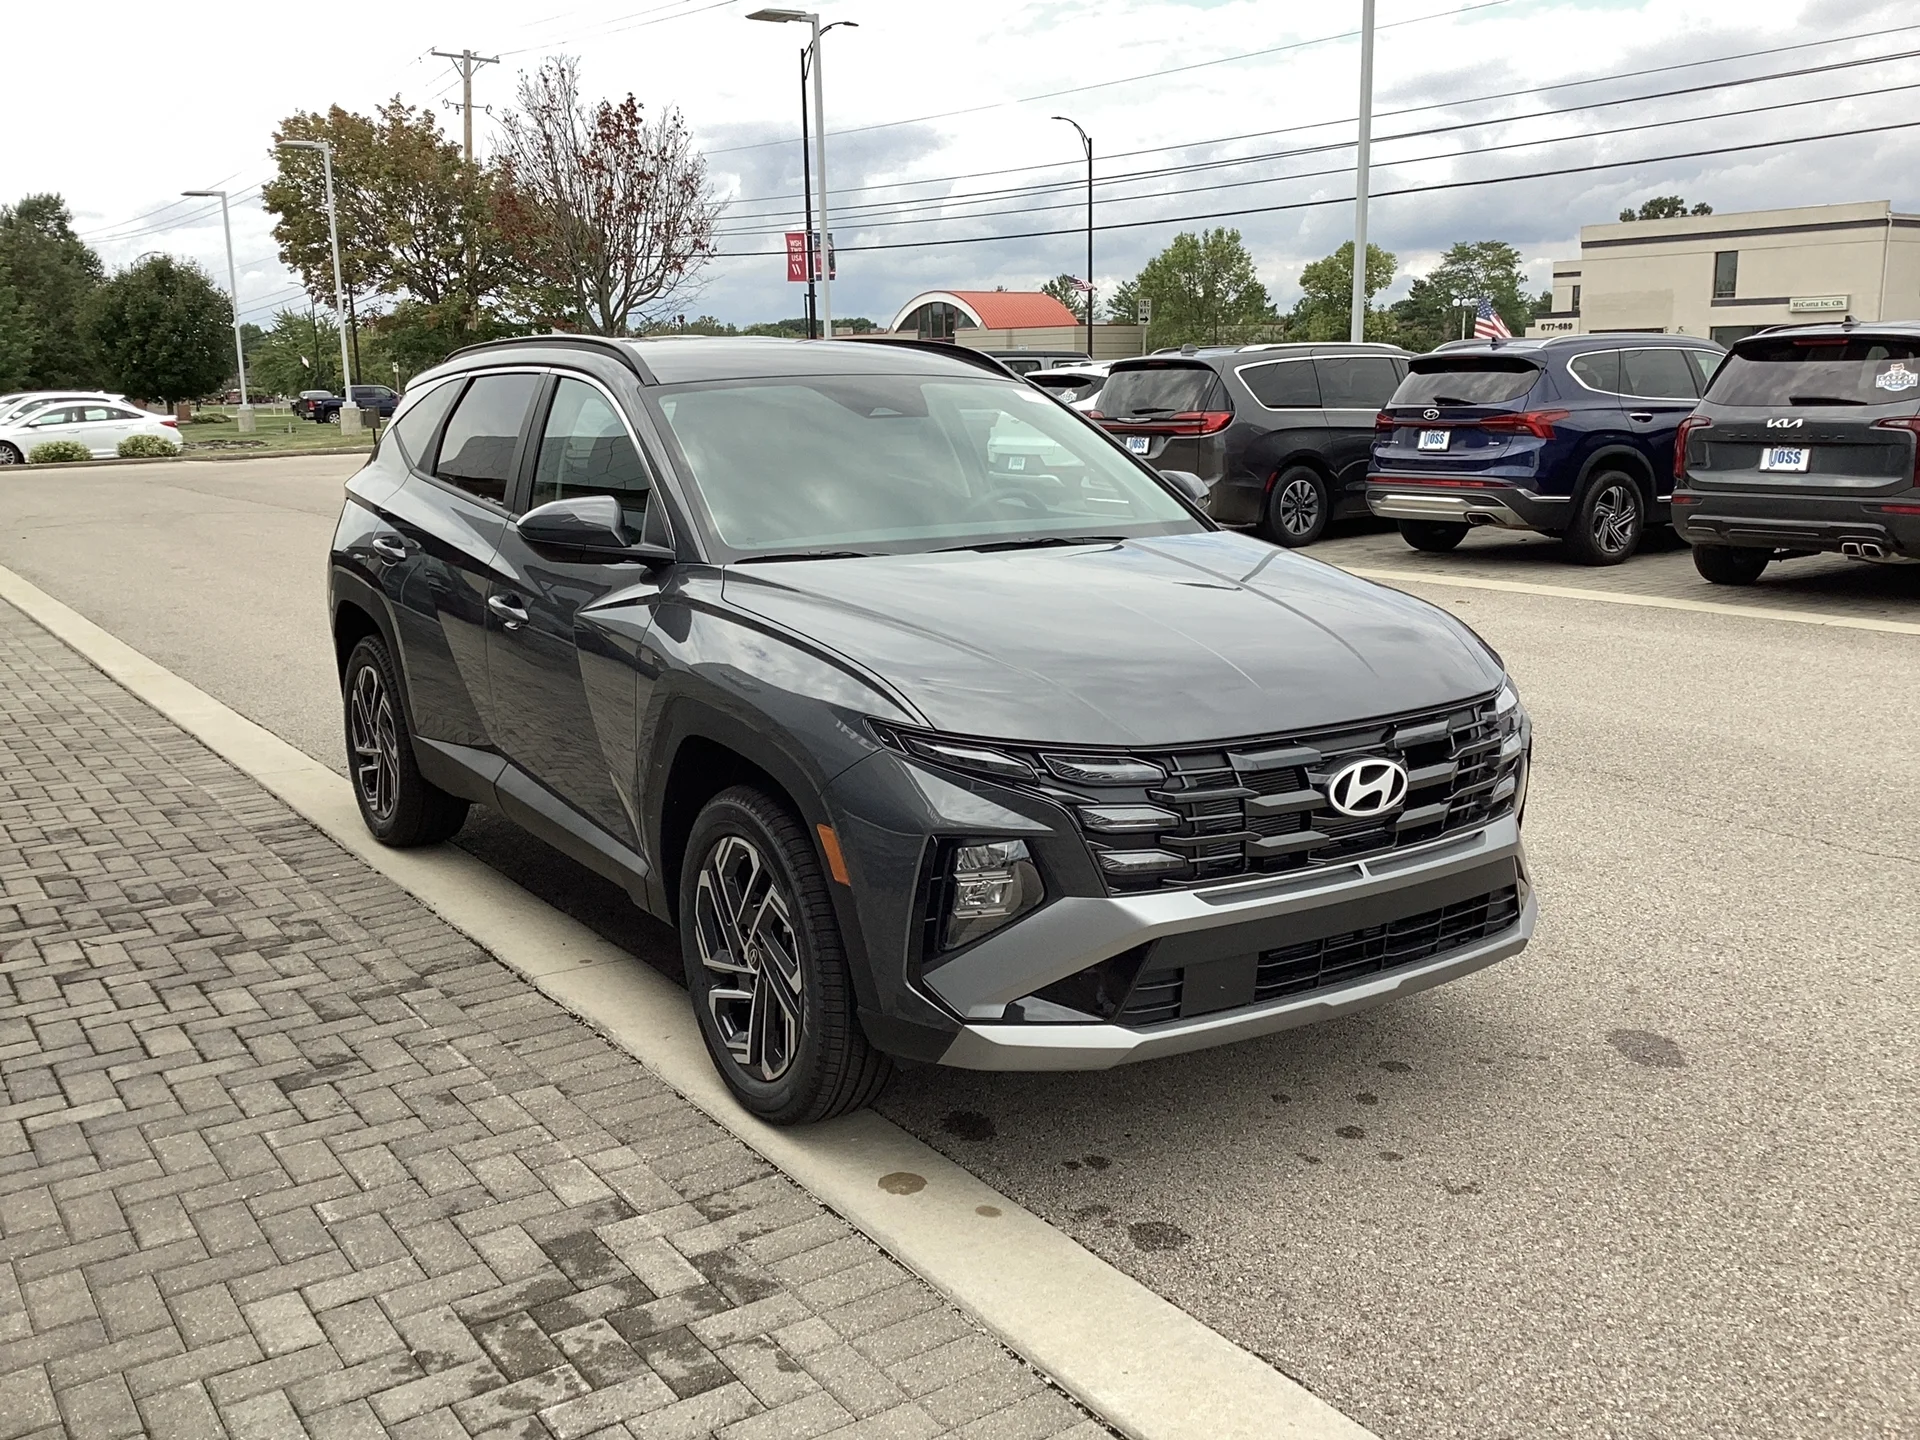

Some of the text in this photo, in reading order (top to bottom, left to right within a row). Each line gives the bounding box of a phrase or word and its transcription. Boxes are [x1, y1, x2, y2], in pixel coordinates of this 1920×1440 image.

[791, 254, 803, 262] USA
[1140, 300, 1151, 308] ONE
[1540, 322, 1573, 331] 677-689
[1766, 418, 1804, 428] KIA
